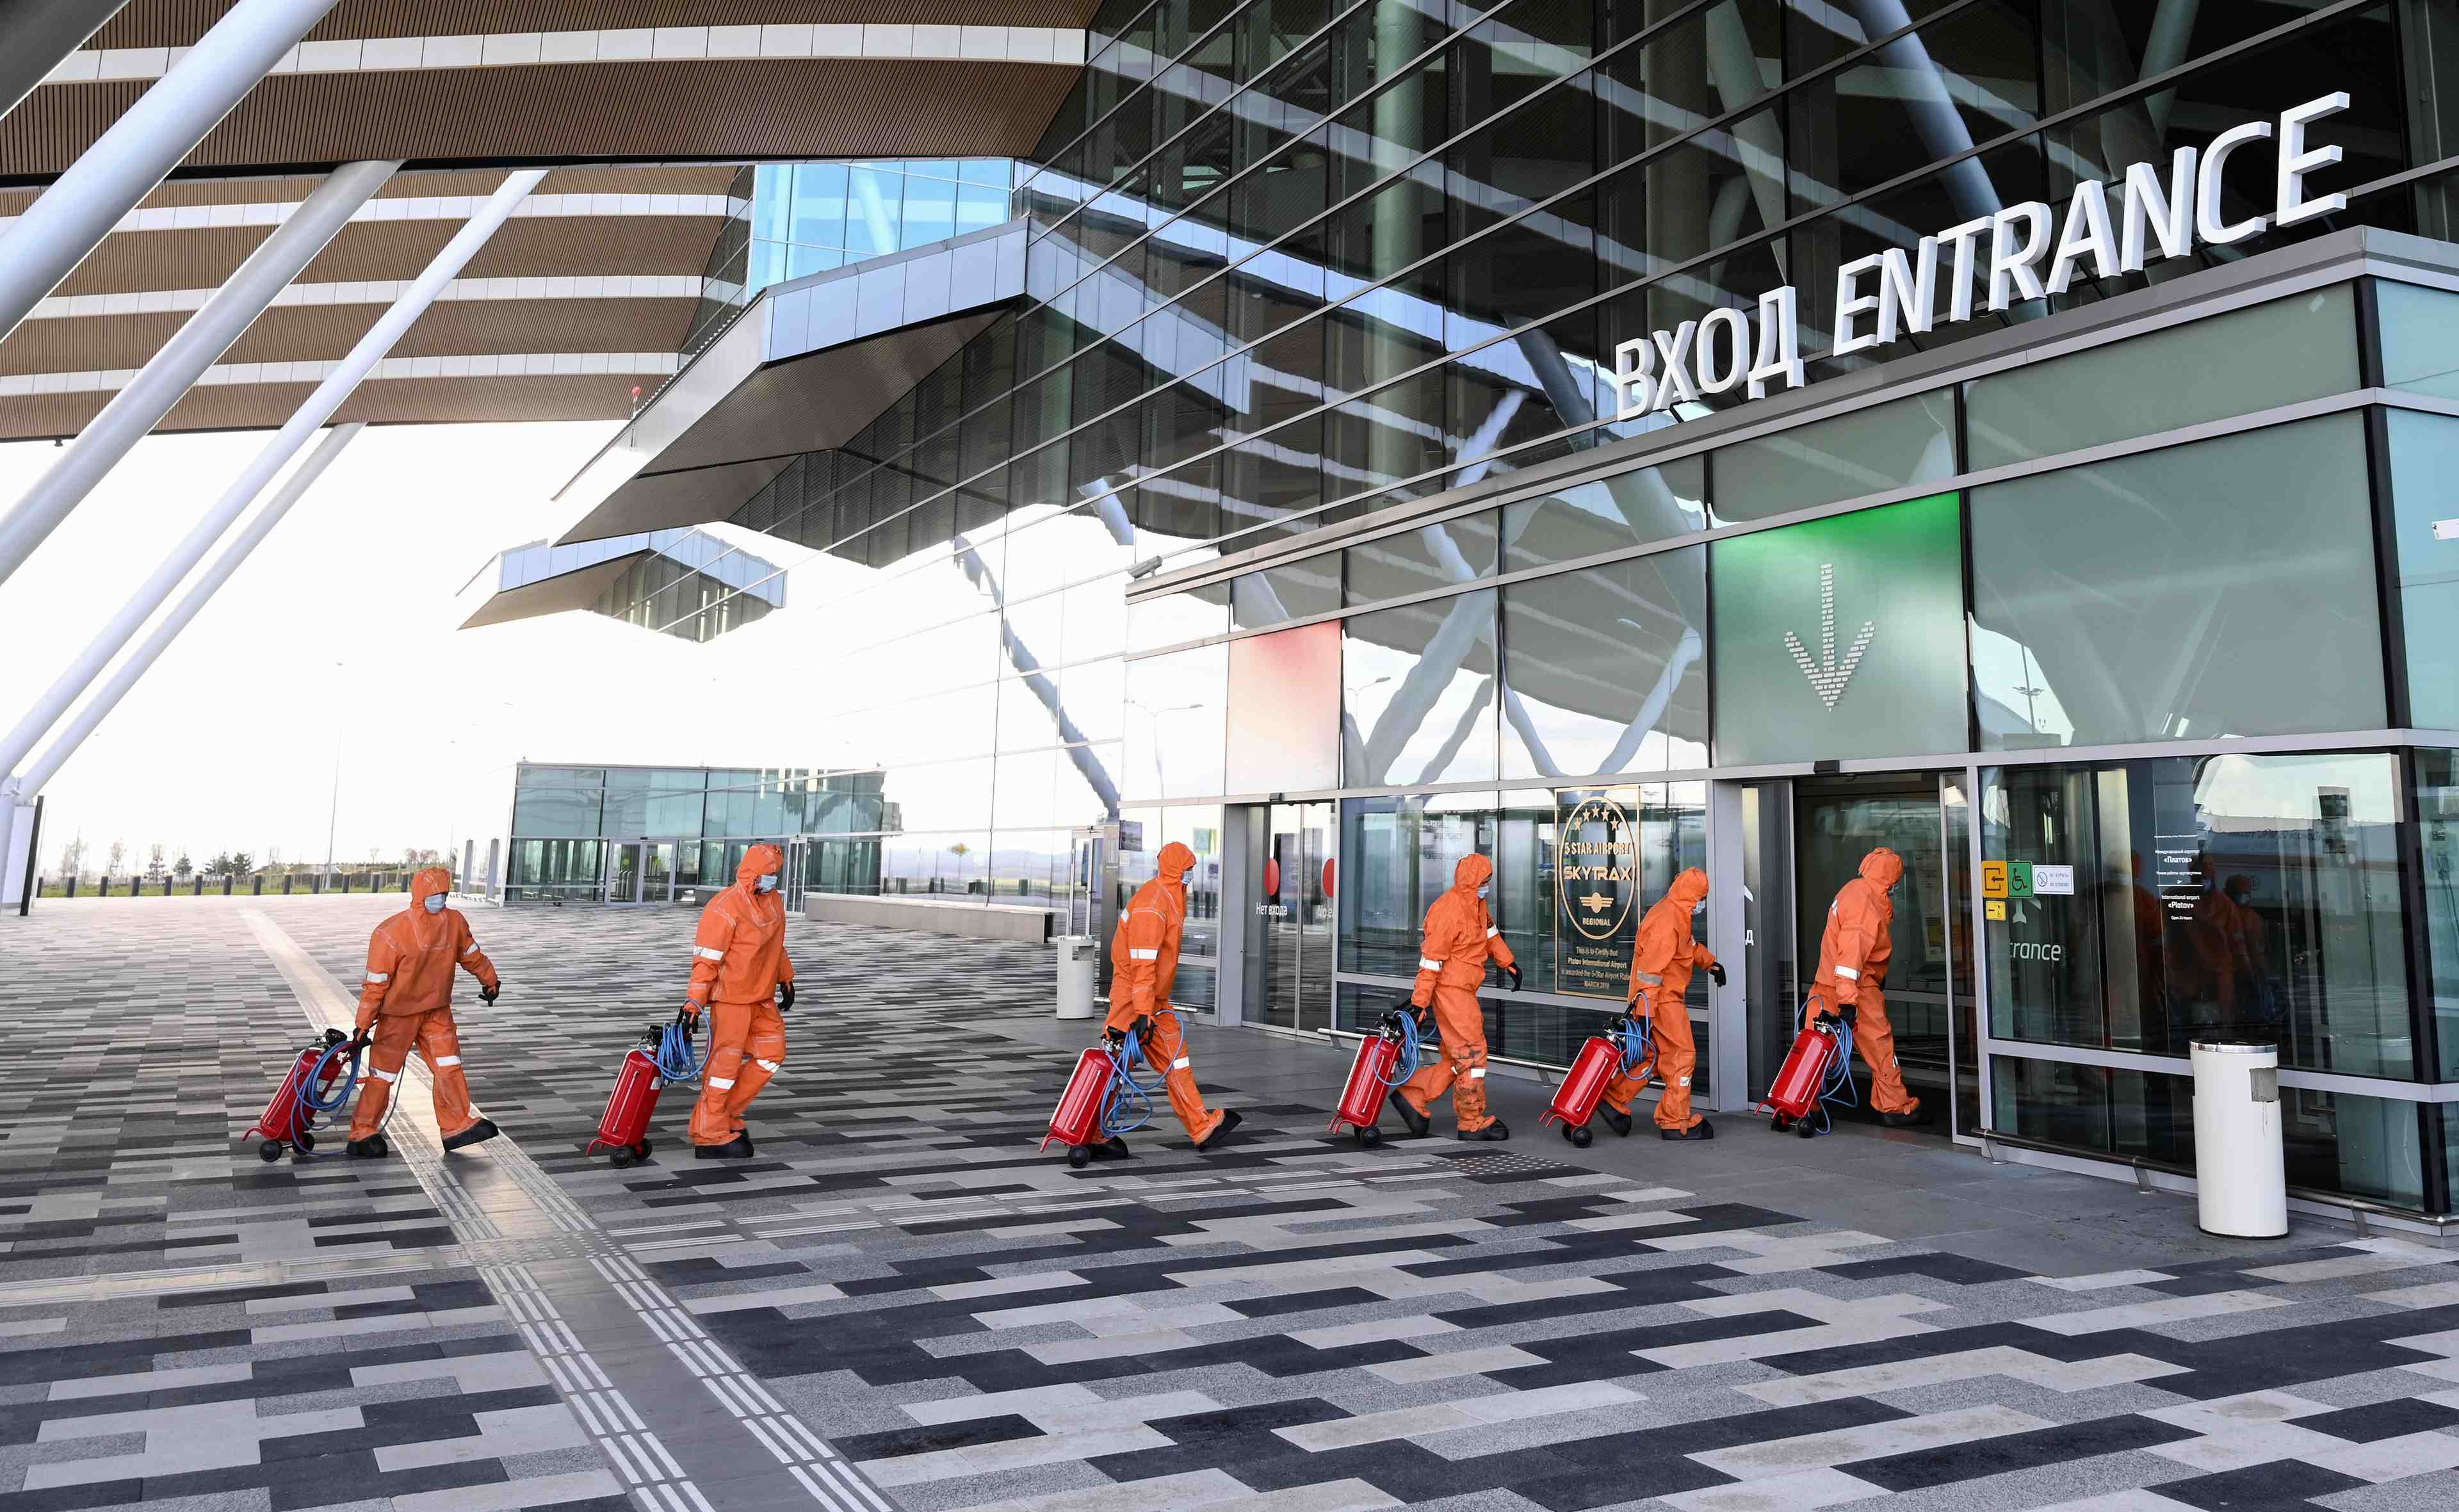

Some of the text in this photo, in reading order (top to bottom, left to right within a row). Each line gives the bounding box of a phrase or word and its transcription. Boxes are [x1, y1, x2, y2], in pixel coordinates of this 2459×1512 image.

[1833, 91, 2349, 356] ENTRANCE
[1616, 286, 1804, 421] ВХОД
[1593, 842, 1630, 855] AIRPORT
[1563, 866, 1632, 881] SKYTRAX
[1256, 902, 1288, 916] Нет входа
[1582, 917, 1611, 927] REGIONAL
